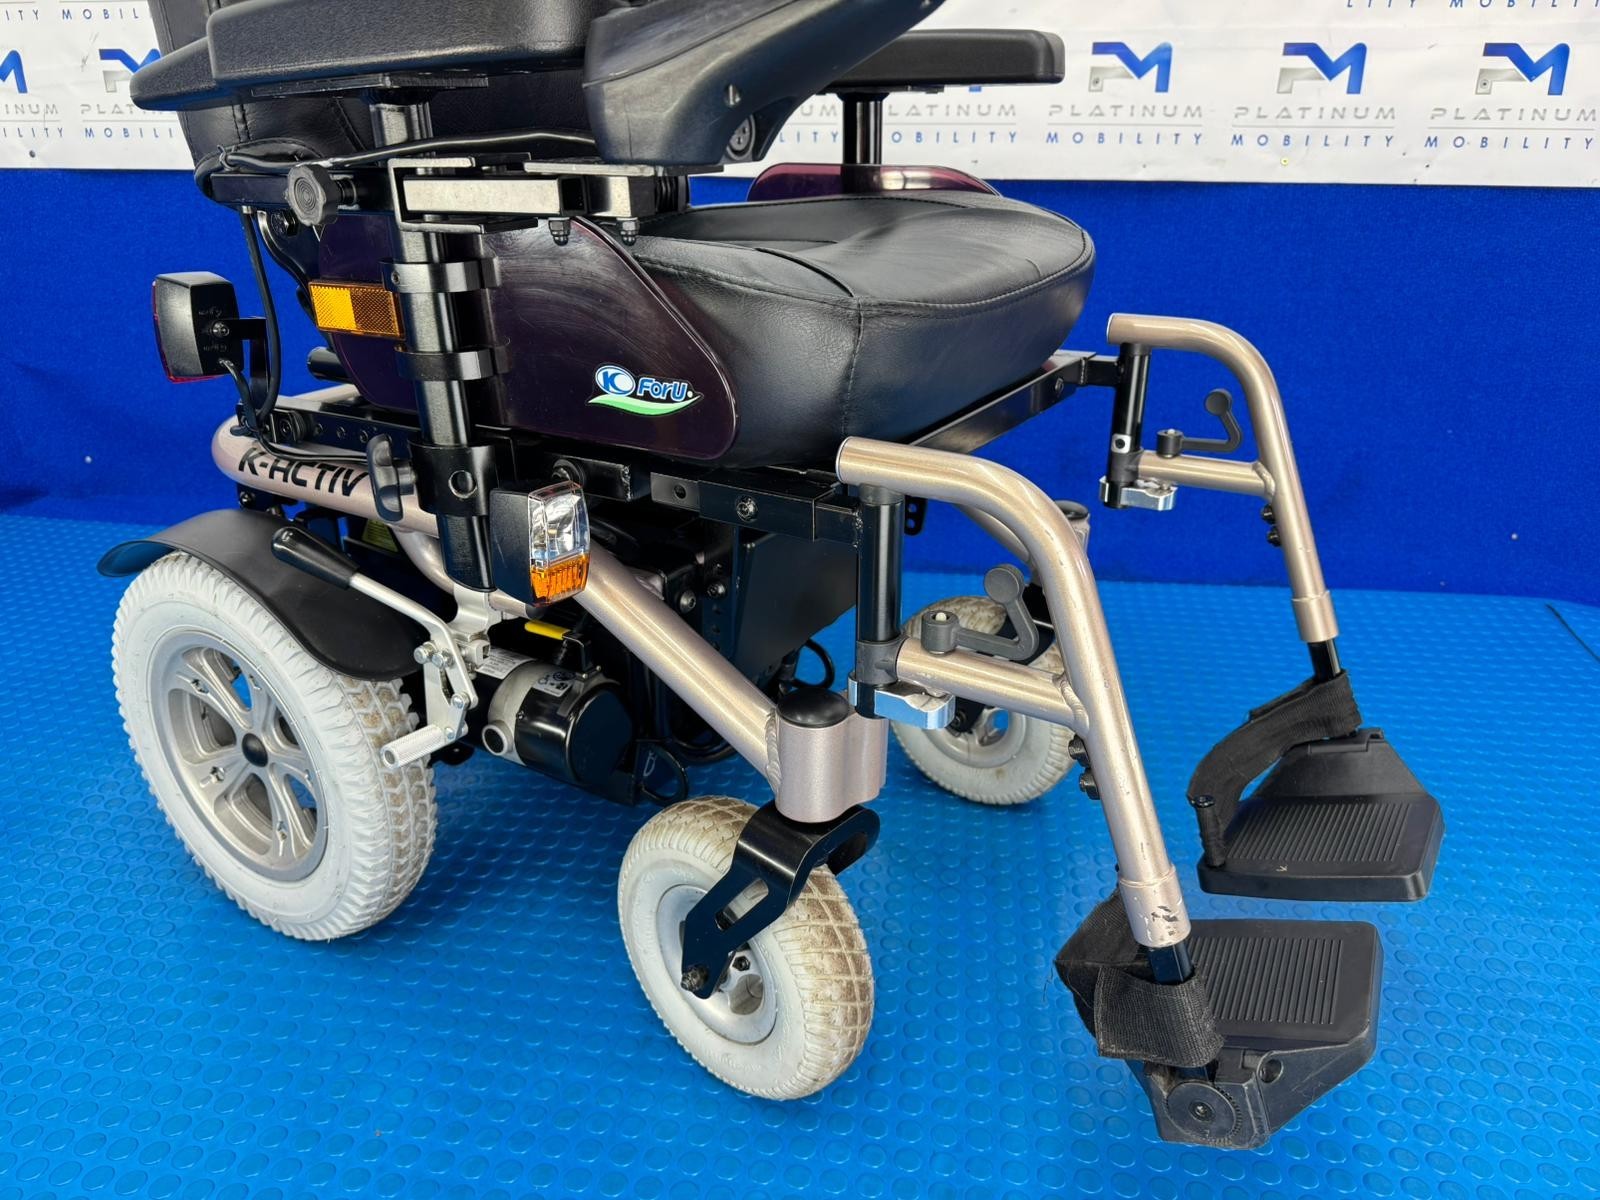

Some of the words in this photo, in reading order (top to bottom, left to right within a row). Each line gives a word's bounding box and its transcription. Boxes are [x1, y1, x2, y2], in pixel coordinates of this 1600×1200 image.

[62, 9, 139, 20] MOBIL
[5, 103, 59, 115] INUM
[888, 104, 1016, 117] LATINUM
[1048, 104, 1203, 118] PLATINUM
[1234, 106, 1396, 119] PLATINUM
[1430, 108, 1597, 121] PLATINUM
[3, 127, 63, 138] ILITY
[84, 127, 174, 138] MOBILI
[779, 131, 838, 143] LITY
[892, 131, 1017, 143] OBILITY
[1046, 131, 1202, 145] MOBILITY
[1231, 134, 1394, 147] MOBILITY
[1424, 136, 1594, 149] MOBILITY
